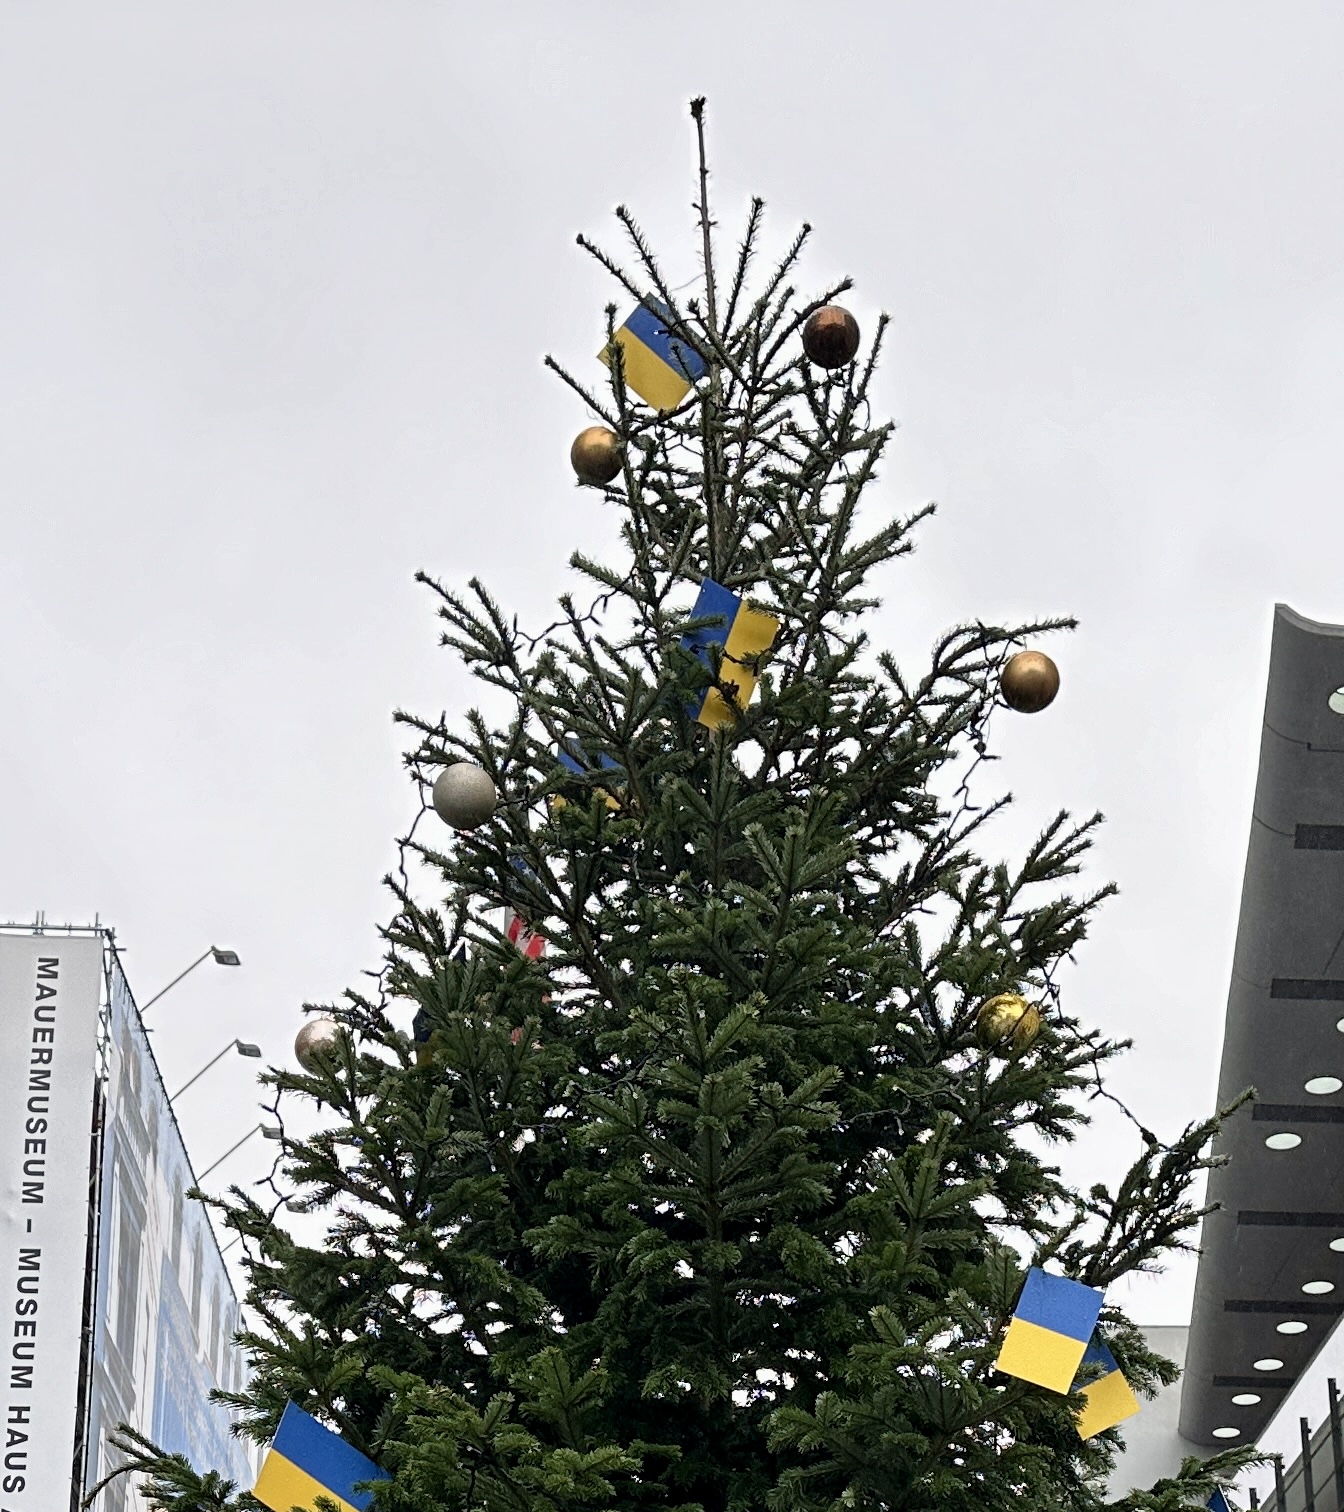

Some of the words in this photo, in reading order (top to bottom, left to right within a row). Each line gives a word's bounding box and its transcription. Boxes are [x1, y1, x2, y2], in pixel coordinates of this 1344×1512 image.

[22, 957, 60, 1204] MAUERMUSEUM
[10, 1248, 42, 1389] MUSEUM
[2, 1405, 31, 1493] HAUS
